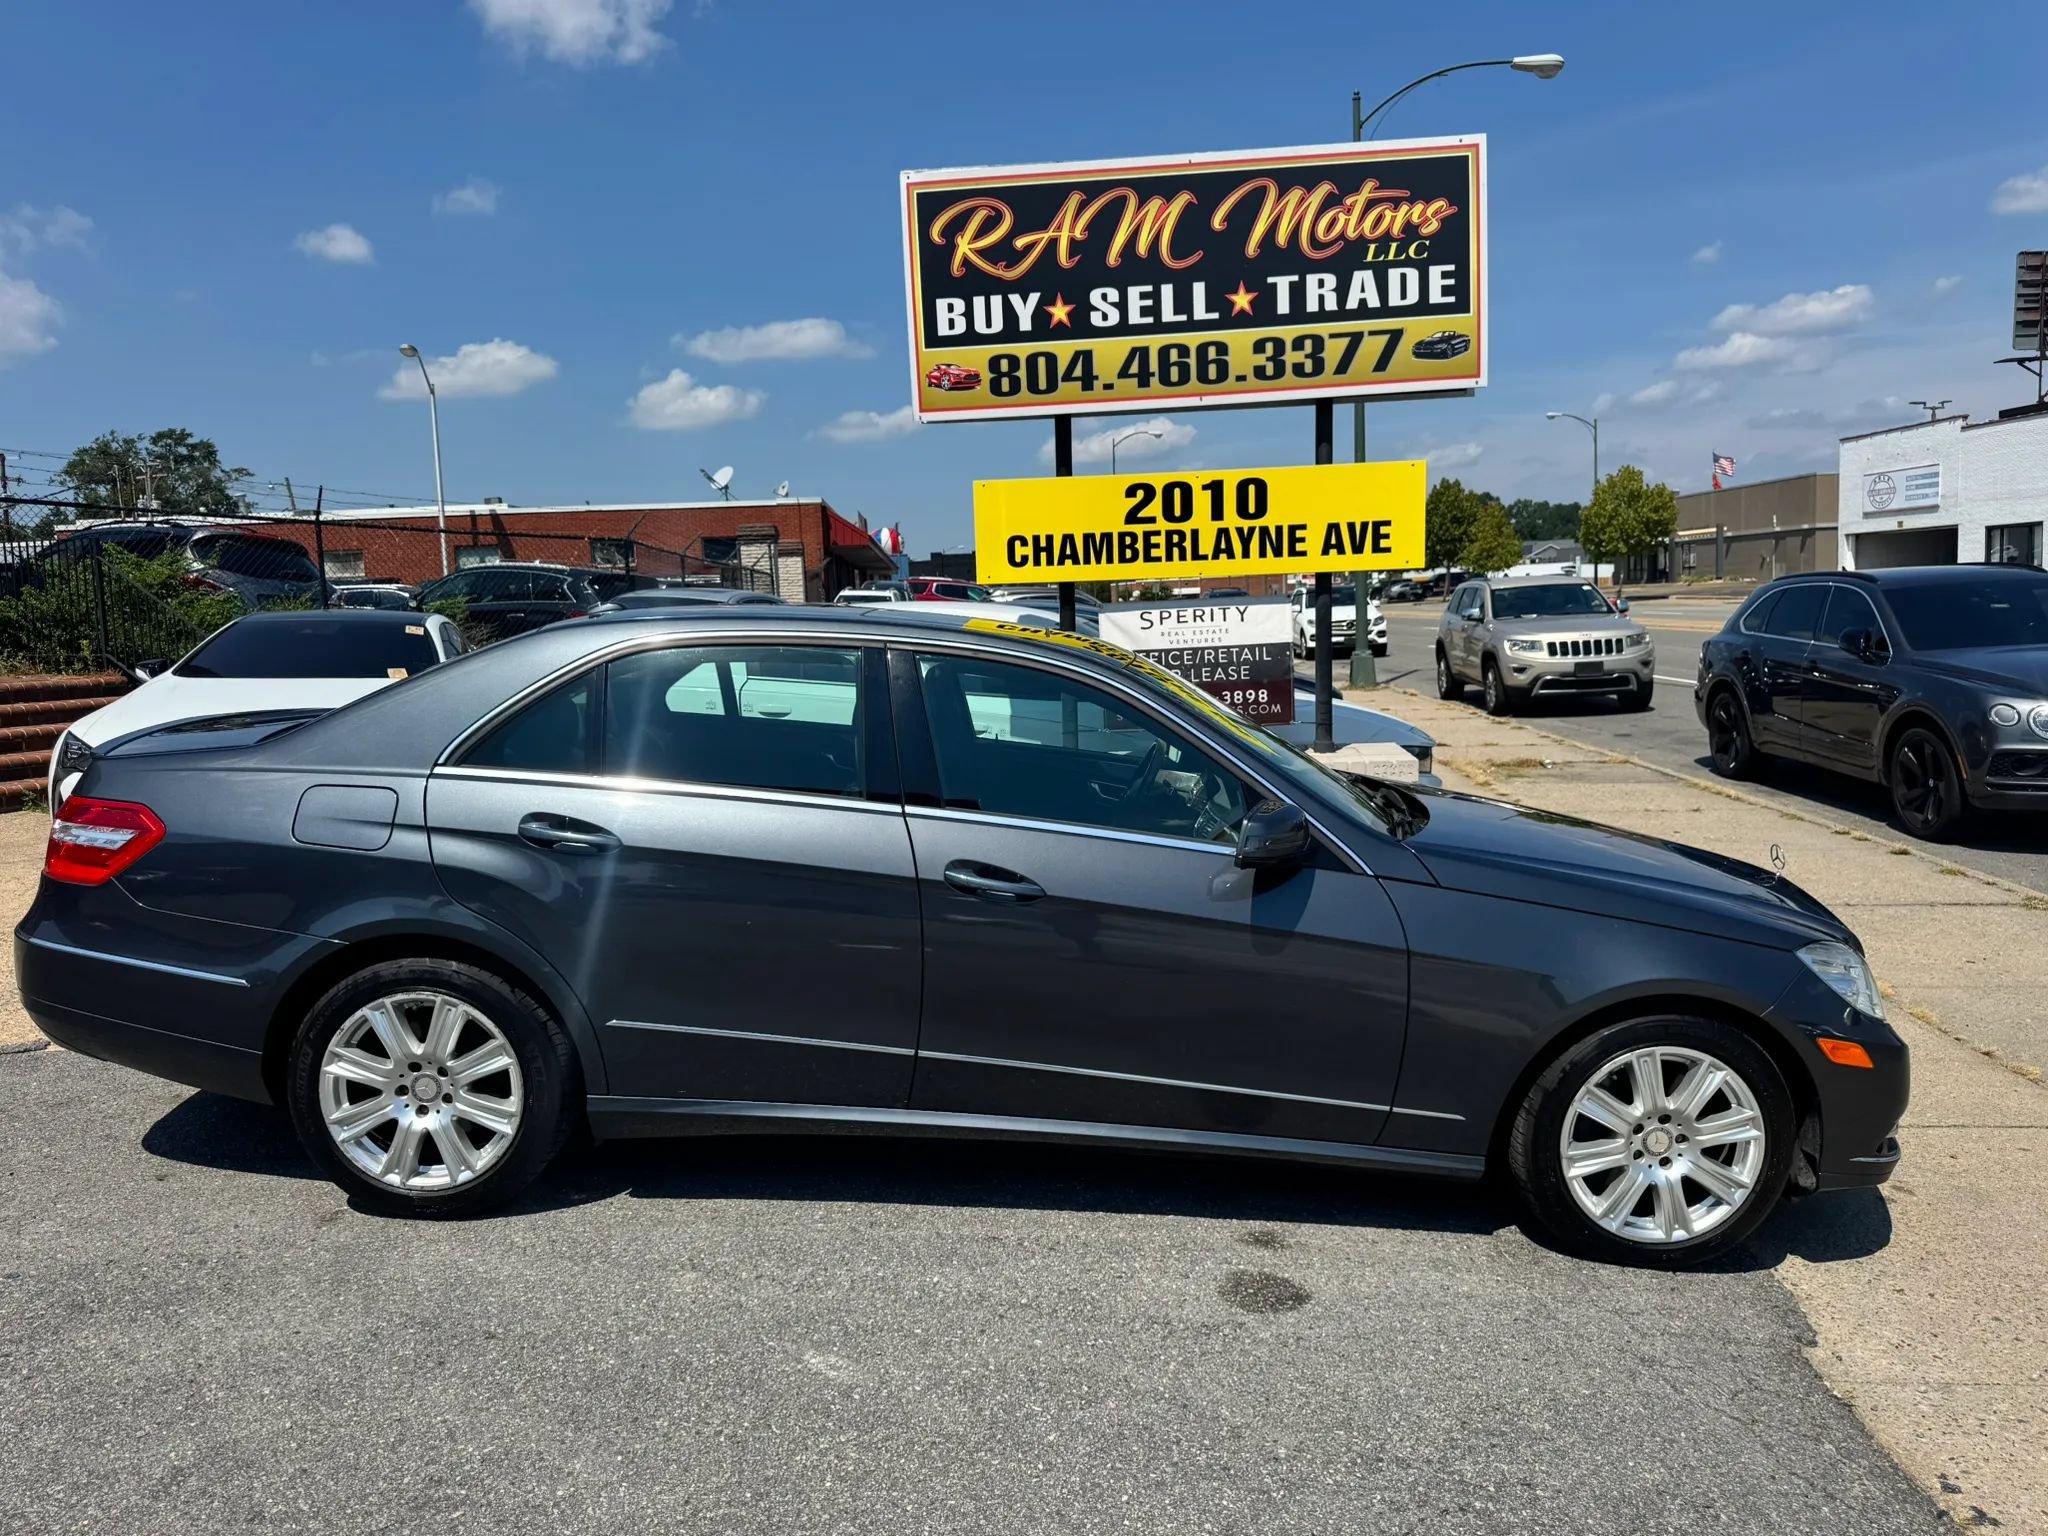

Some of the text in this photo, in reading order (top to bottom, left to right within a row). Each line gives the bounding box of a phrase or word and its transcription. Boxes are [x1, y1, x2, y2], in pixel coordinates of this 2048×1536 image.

[929, 177, 1458, 281] RAM Motors
[1363, 240, 1431, 263] LLC
[935, 264, 1456, 337] BUY SELL TRADE
[987, 327, 1404, 398] 804.466.3377
[1123, 477, 1269, 526] 2010
[1006, 519, 1393, 569] CHAMBERLAYNE AVE
[1139, 605, 1249, 630] SPERITY
[1168, 636, 1223, 645] VENTURES
[1192, 628, 1230, 636] ESTATE
[1139, 646, 1272, 667] FICE/RETAIL
[1191, 665, 1250, 682] LEASE
